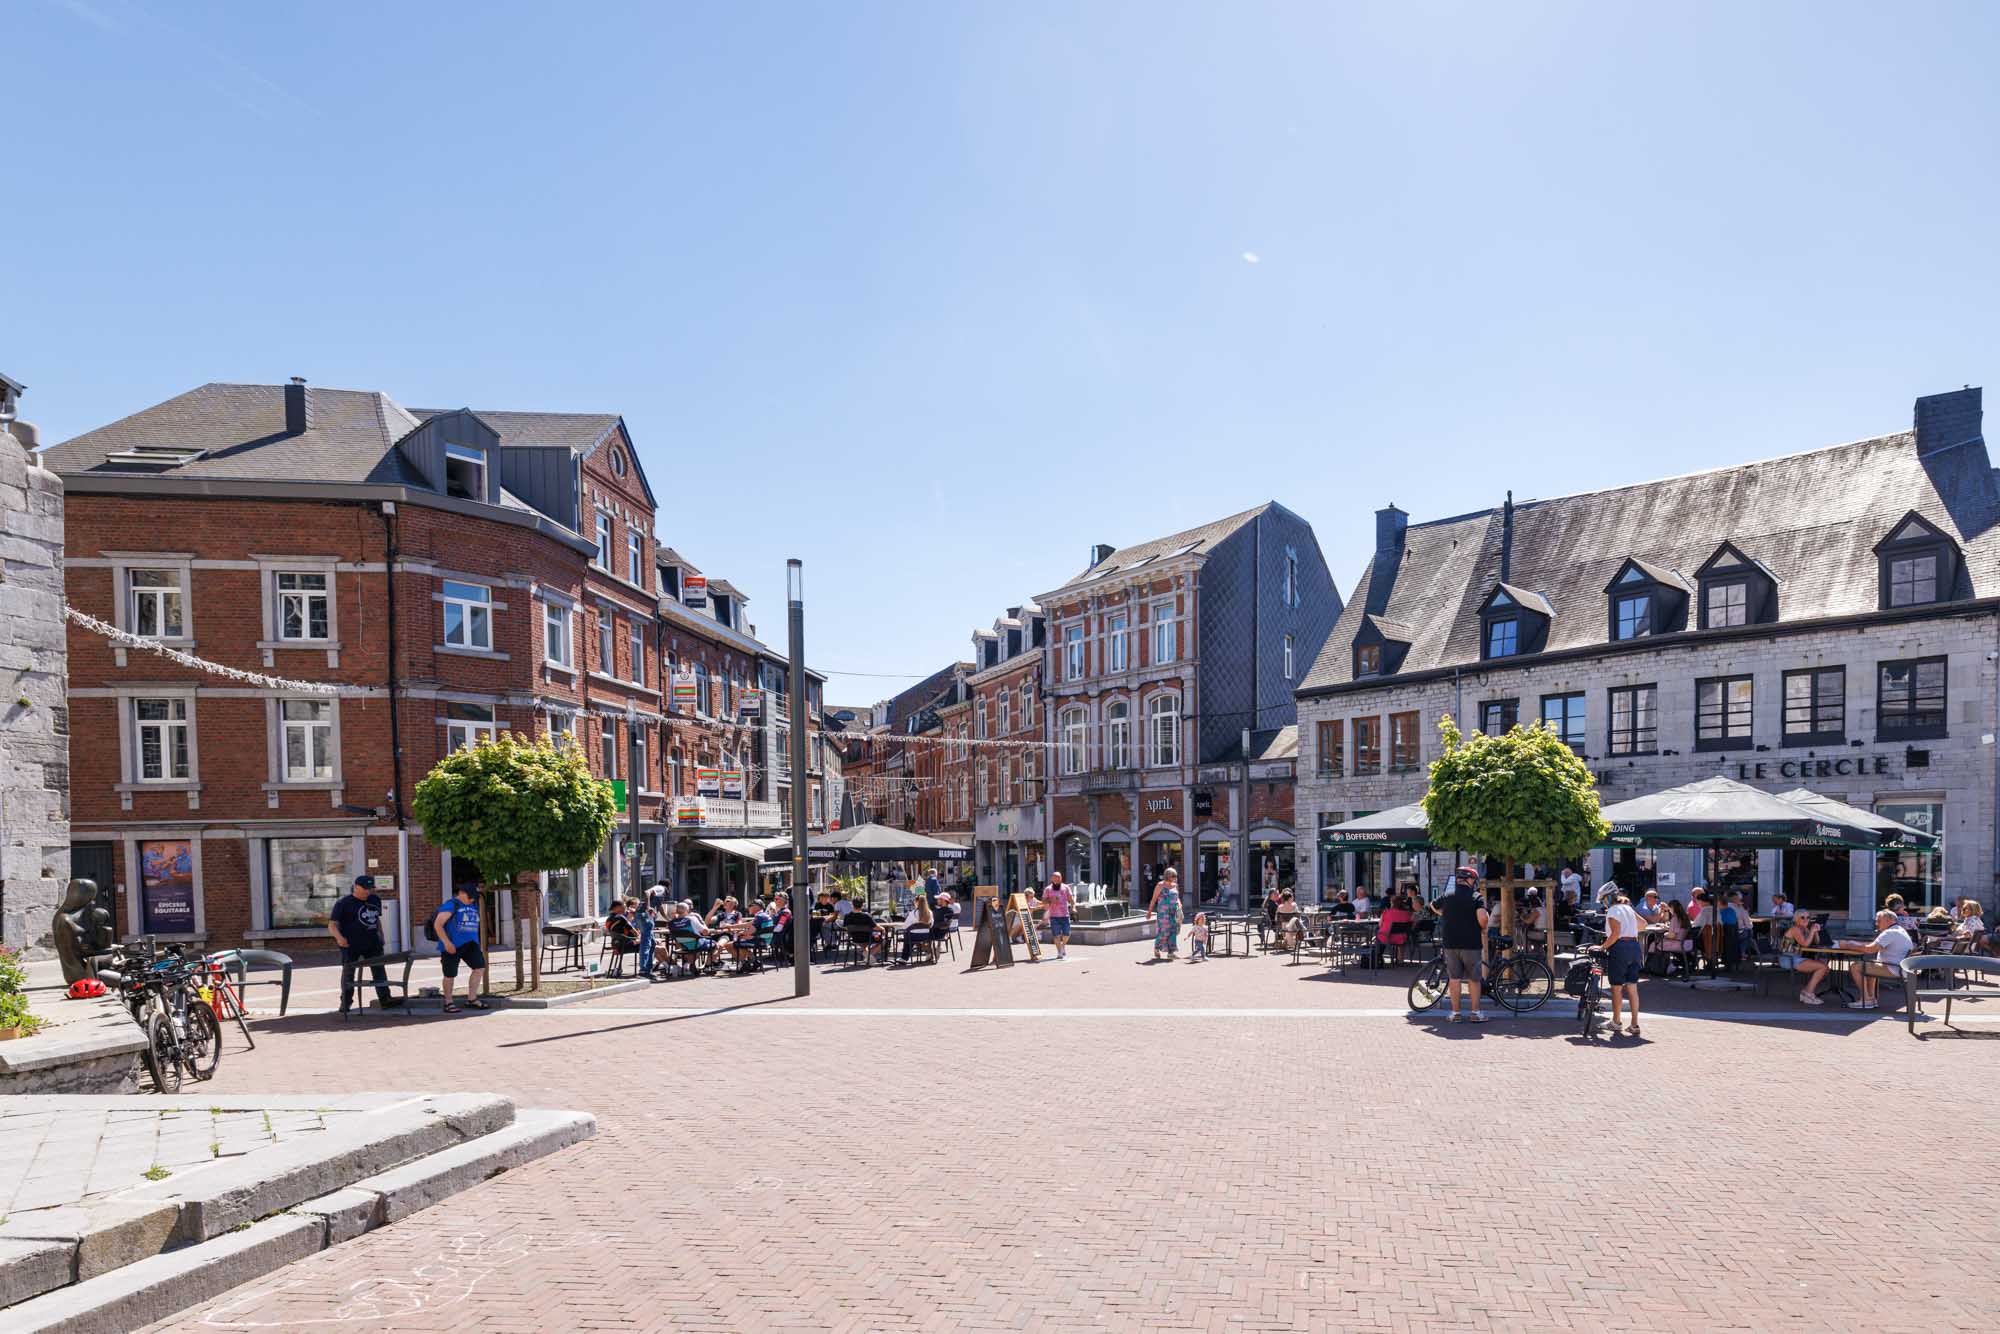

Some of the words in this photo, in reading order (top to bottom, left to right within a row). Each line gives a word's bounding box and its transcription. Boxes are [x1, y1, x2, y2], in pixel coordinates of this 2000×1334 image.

[1739, 764, 1769, 780] LE
[1780, 756, 1890, 778] CERCLE
[1345, 832, 1388, 841] BOFFERDING
